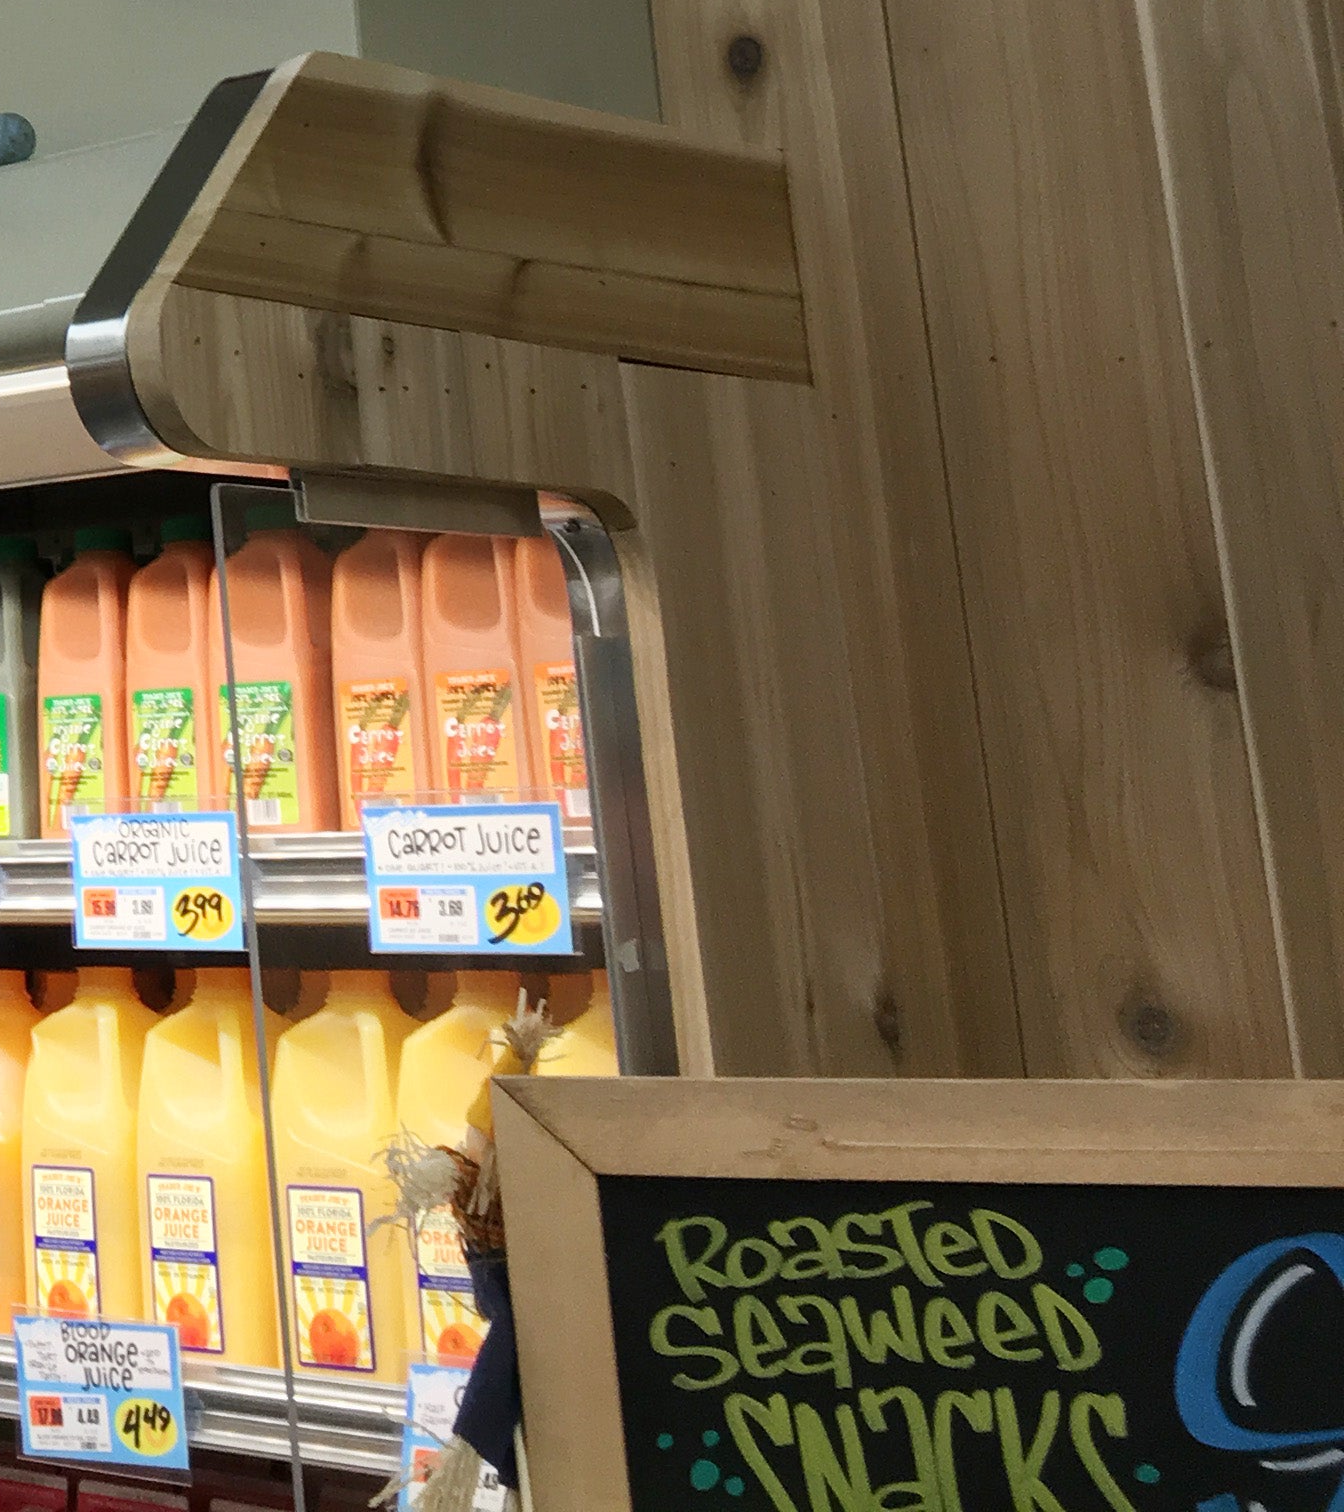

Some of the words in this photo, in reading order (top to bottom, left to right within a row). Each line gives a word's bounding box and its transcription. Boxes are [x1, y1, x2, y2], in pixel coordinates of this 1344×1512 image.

[118, 820, 190, 839] ORGANIC
[388, 826, 467, 859] CARROT
[476, 823, 542, 856] JUICE
[92, 840, 161, 866] CARROT
[167, 838, 223, 867] JUICE
[38, 1196, 89, 1213] ORANGE
[154, 1207, 208, 1223] ORANGE
[46, 1214, 80, 1228] JUICE
[164, 1224, 199, 1239] JUICE
[295, 1219, 358, 1236] ORANGE
[306, 1237, 348, 1253] JUICE
[655, 1201, 1046, 1302] Roasted
[60, 1320, 111, 1342] BLOOD
[650, 1281, 1103, 1392] Seaweed
[64, 1340, 139, 1368] ORANGE
[81, 1366, 134, 1392] JUICE
[122, 1402, 172, 1449] 449
